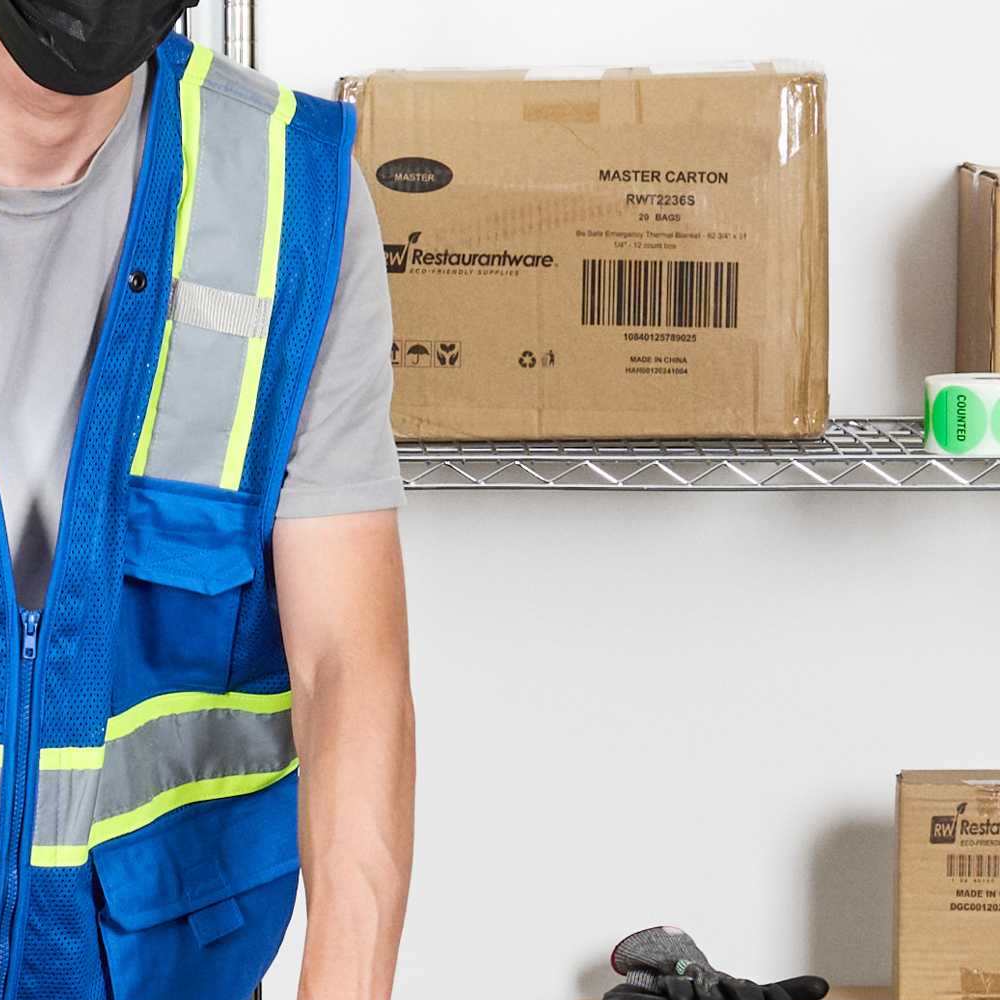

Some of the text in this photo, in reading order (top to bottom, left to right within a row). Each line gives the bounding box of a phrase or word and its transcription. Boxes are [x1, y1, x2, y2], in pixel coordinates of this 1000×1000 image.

[393, 172, 435, 182] MASTER
[599, 169, 728, 184] MASTER CARTON
[626, 193, 696, 206] RWT2236S
[655, 213, 681, 222] BAGS
[605, 230, 643, 240] Emergency
[645, 230, 675, 239] Thermal
[412, 249, 554, 268] Restaurantware
[410, 267, 520, 277] ECO-FRIENDLY SUPPLIES
[630, 355, 688, 364] MADE IN CHINA
[956, 394, 967, 442] COUNTED
[934, 823, 955, 838] RW
[956, 889, 983, 898] MADE
[986, 889, 996, 898] IN
